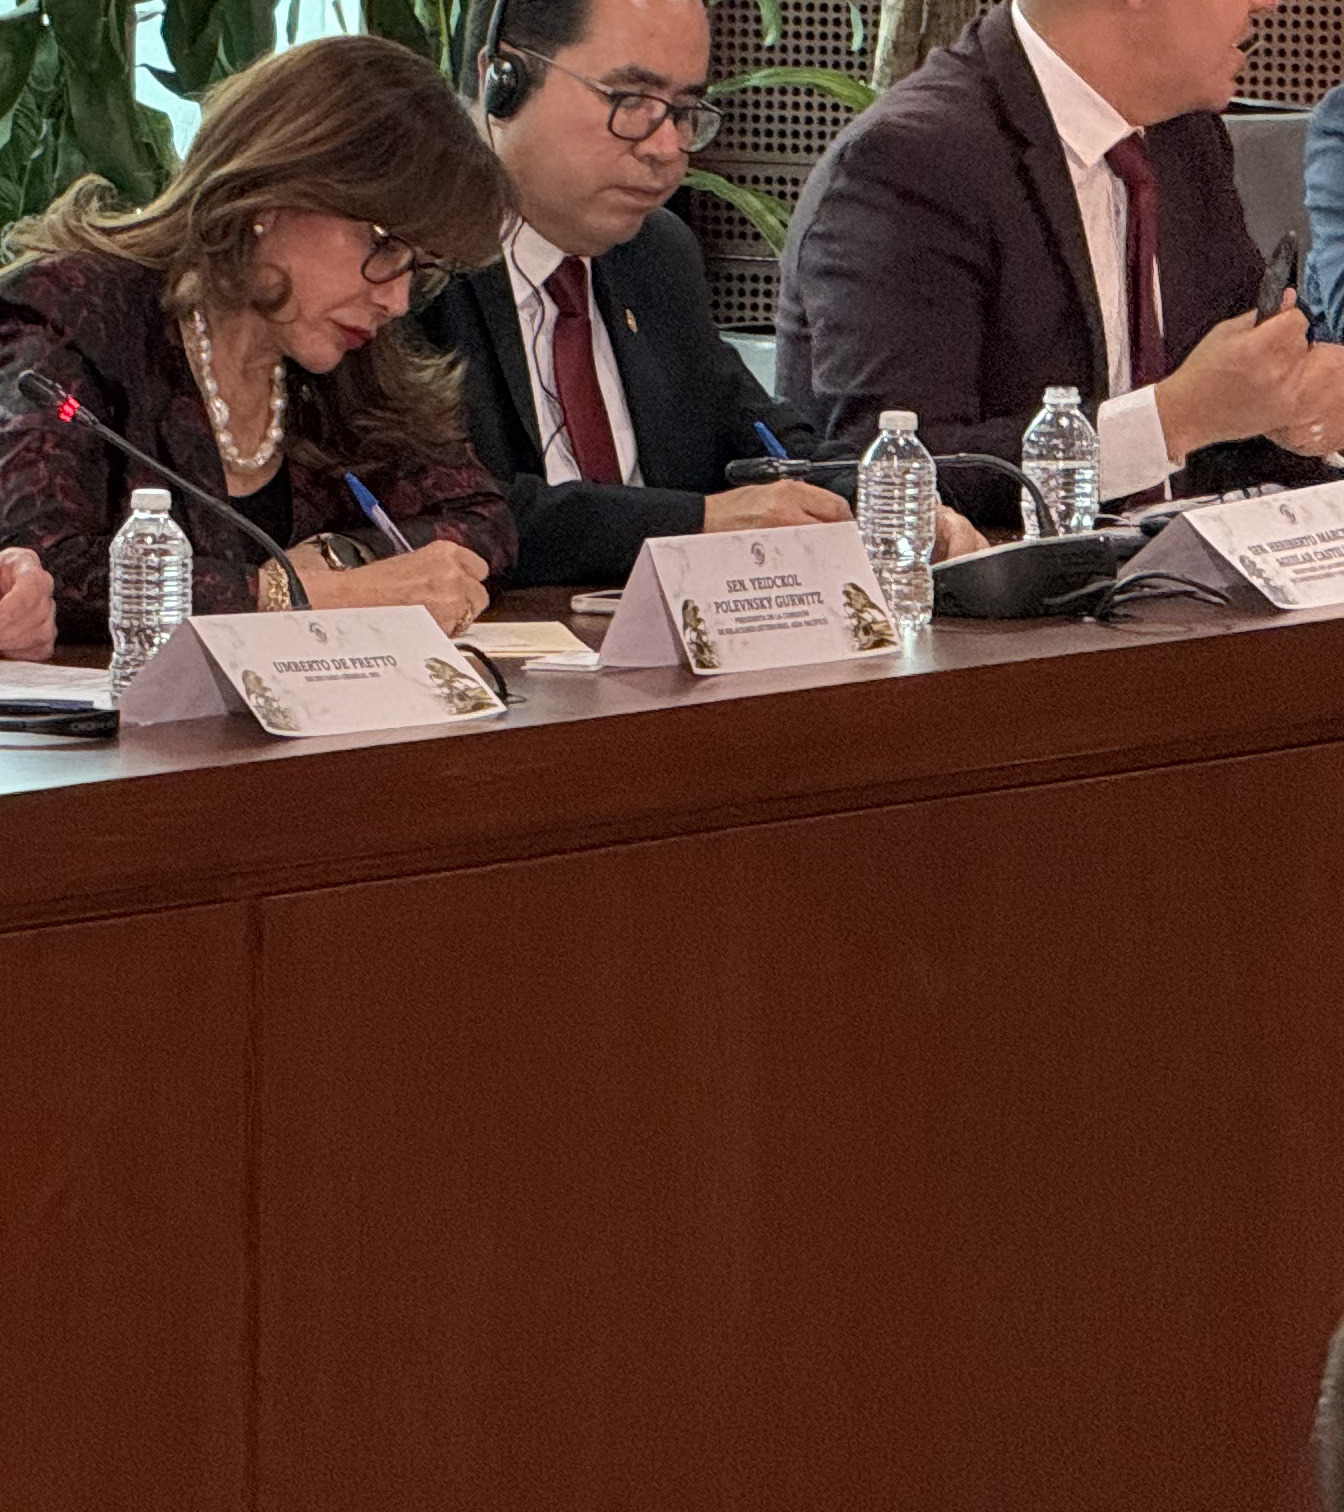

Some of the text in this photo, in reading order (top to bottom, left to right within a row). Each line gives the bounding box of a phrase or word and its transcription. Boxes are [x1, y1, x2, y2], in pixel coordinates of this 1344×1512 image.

[714, 596, 772, 614] POLEVNSKY
[273, 655, 398, 674] UMBERTO DE PRETTO
